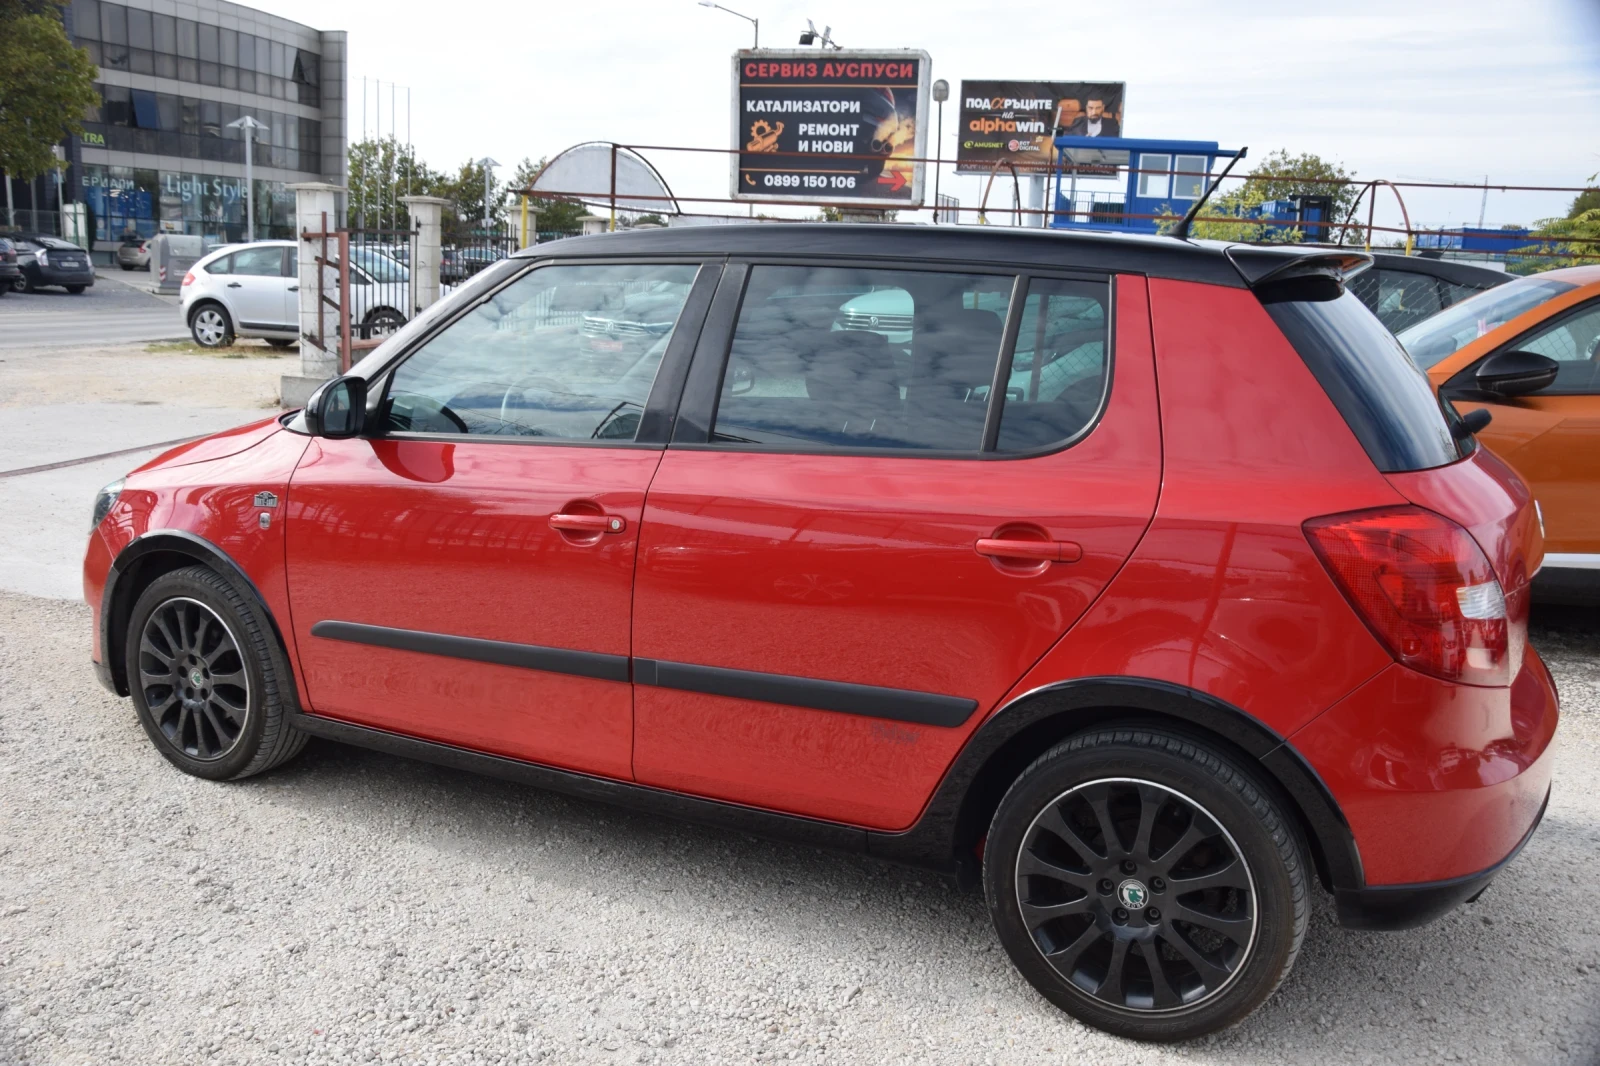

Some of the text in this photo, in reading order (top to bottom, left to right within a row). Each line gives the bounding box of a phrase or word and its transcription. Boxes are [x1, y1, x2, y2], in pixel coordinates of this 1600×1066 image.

[745, 63, 913, 78] СЕРВИЗ АУСПУСИ
[746, 100, 861, 113] КАТАЛИЗАТОРИ
[798, 123, 859, 136] РЕМОНТ
[969, 117, 1045, 135] alphawin
[798, 141, 854, 153] И НОВИ
[974, 141, 1004, 149] AMUSNET
[764, 174, 856, 189] 0899 150 106
[166, 174, 249, 204] Light Style
